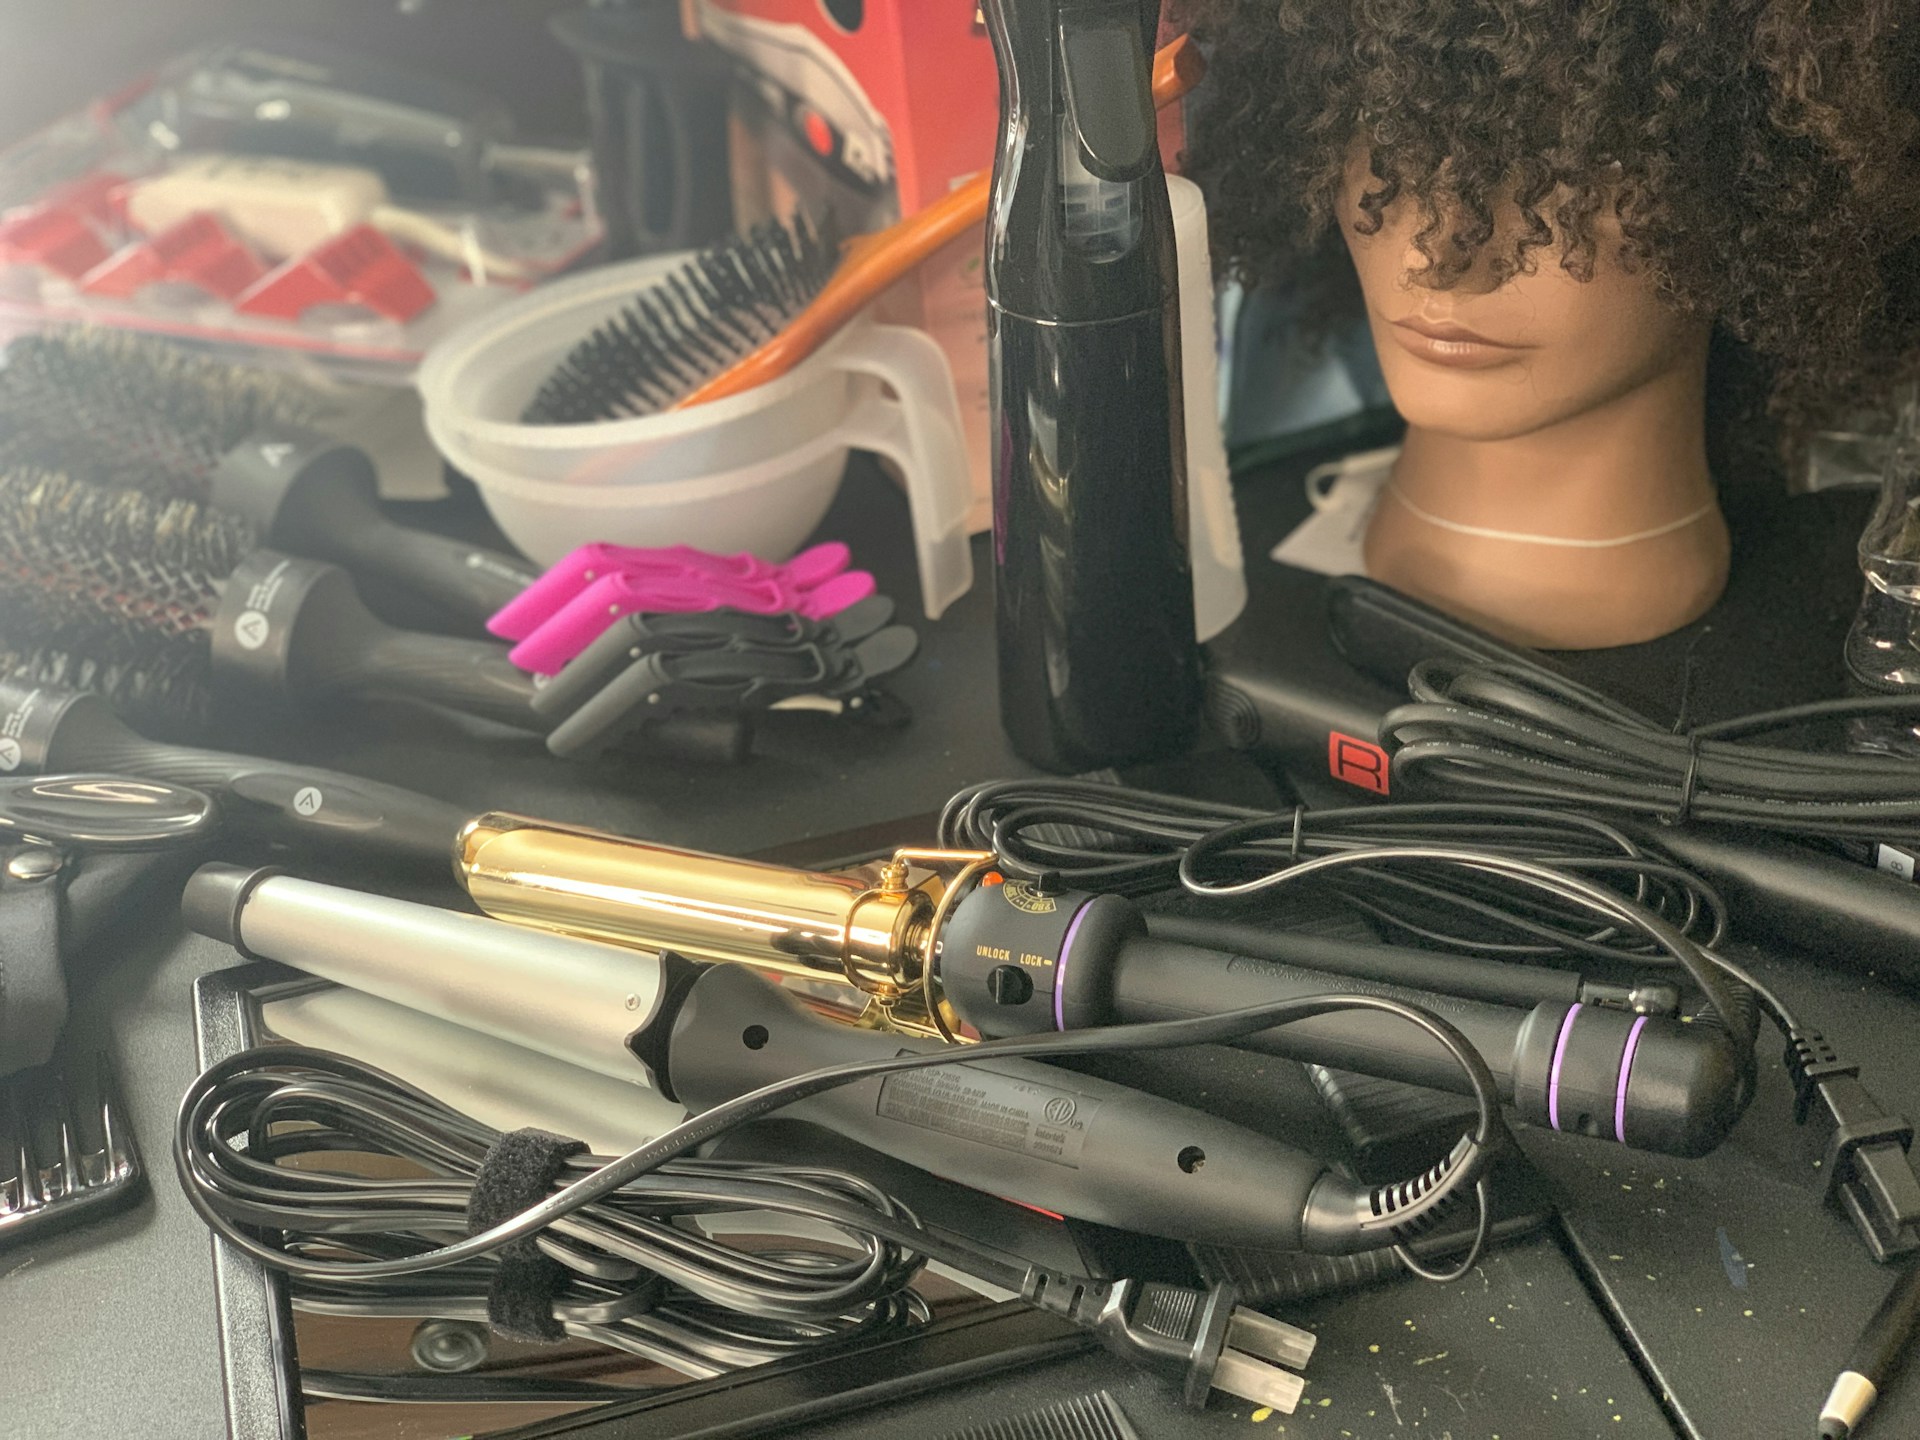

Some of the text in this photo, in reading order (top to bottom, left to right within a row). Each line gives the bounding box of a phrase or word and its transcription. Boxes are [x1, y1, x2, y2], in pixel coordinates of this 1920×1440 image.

[1337, 740, 1382, 789] R
[976, 945, 1043, 967] UNLOCK LOCK
